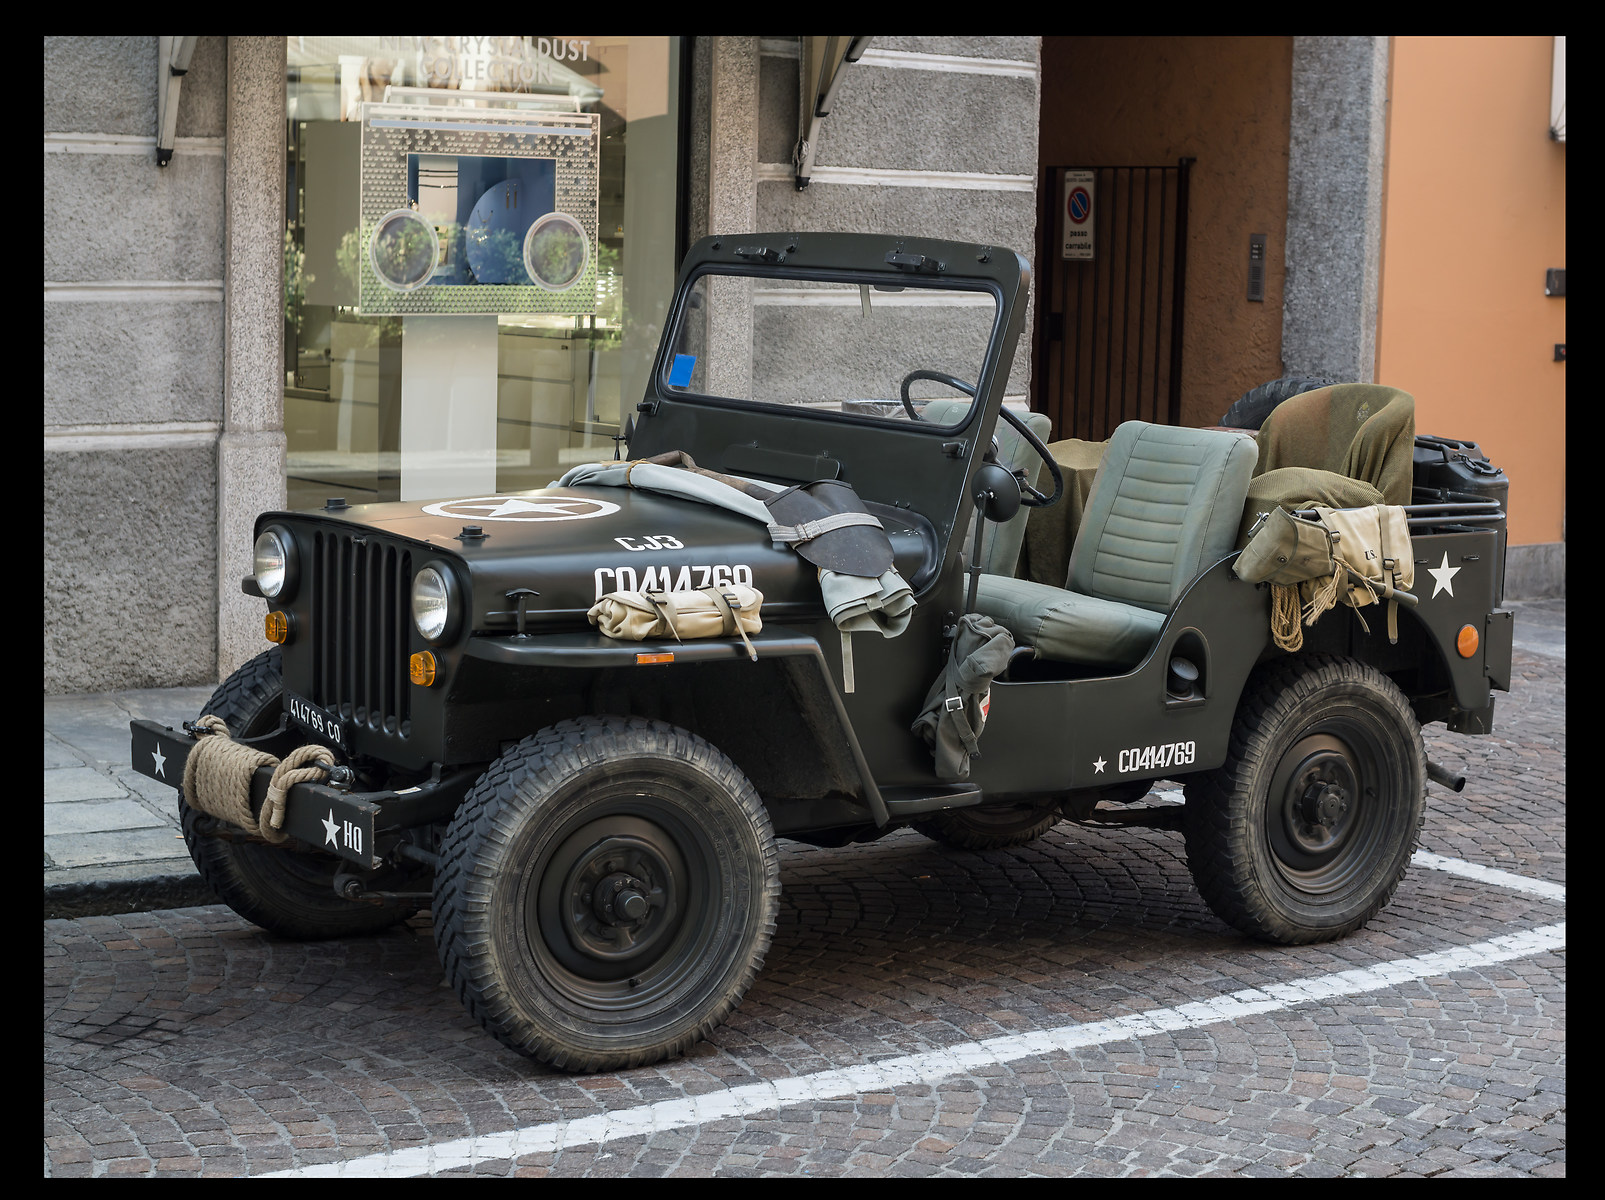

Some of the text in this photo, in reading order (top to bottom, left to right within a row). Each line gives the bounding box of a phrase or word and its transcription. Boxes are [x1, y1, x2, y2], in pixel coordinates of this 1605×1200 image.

[420, 56, 553, 84] COLLECTION
[613, 534, 685, 552] CJ3
[290, 698, 341, 743] 414769 CO
[343, 820, 363, 855] HQ
